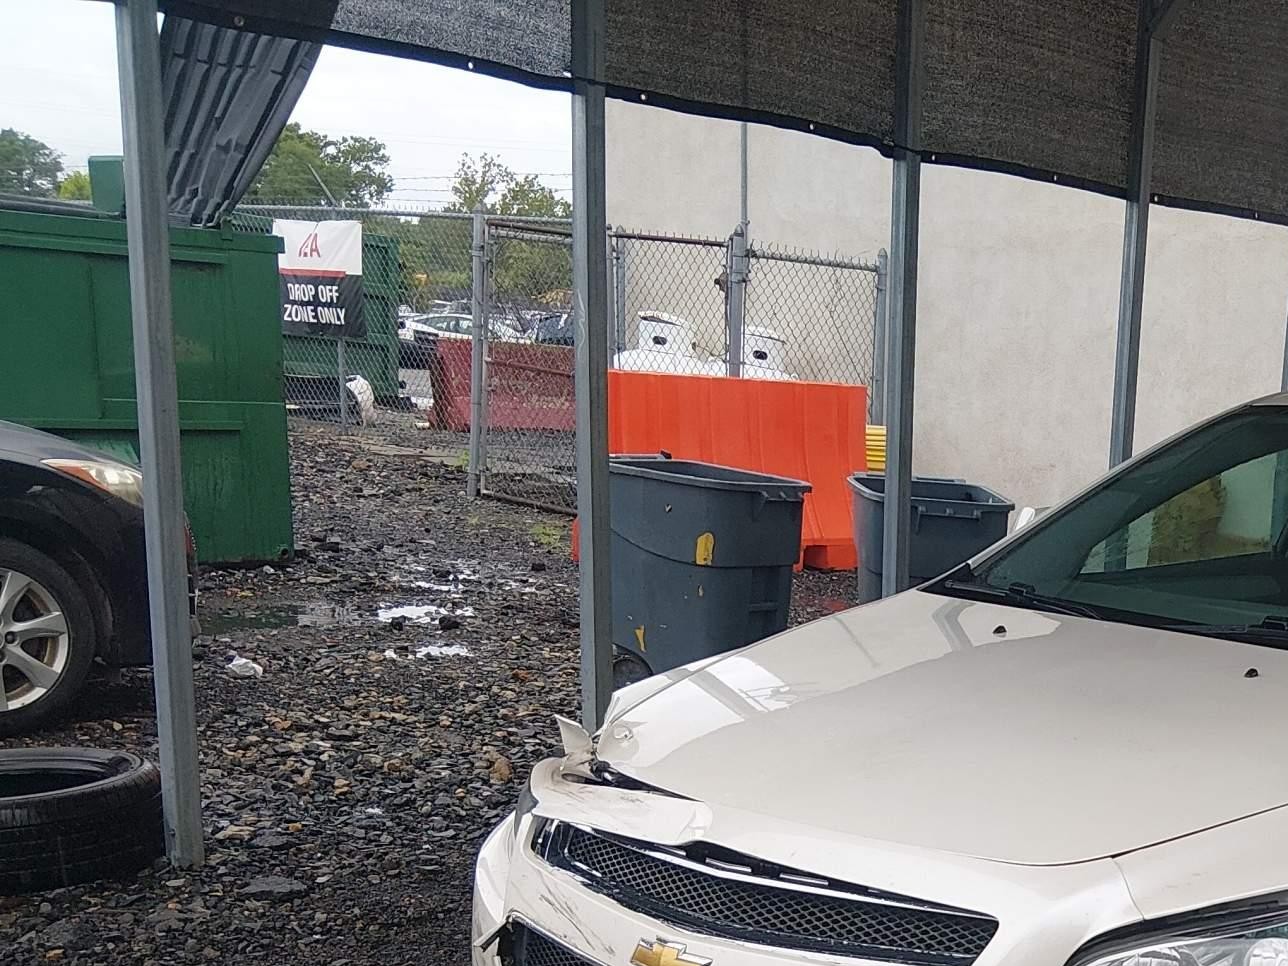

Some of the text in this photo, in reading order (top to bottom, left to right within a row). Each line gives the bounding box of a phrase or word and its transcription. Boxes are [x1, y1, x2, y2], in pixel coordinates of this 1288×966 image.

[287, 283, 340, 303] DROP OFF
[284, 304, 345, 325] ZONE ONLY
